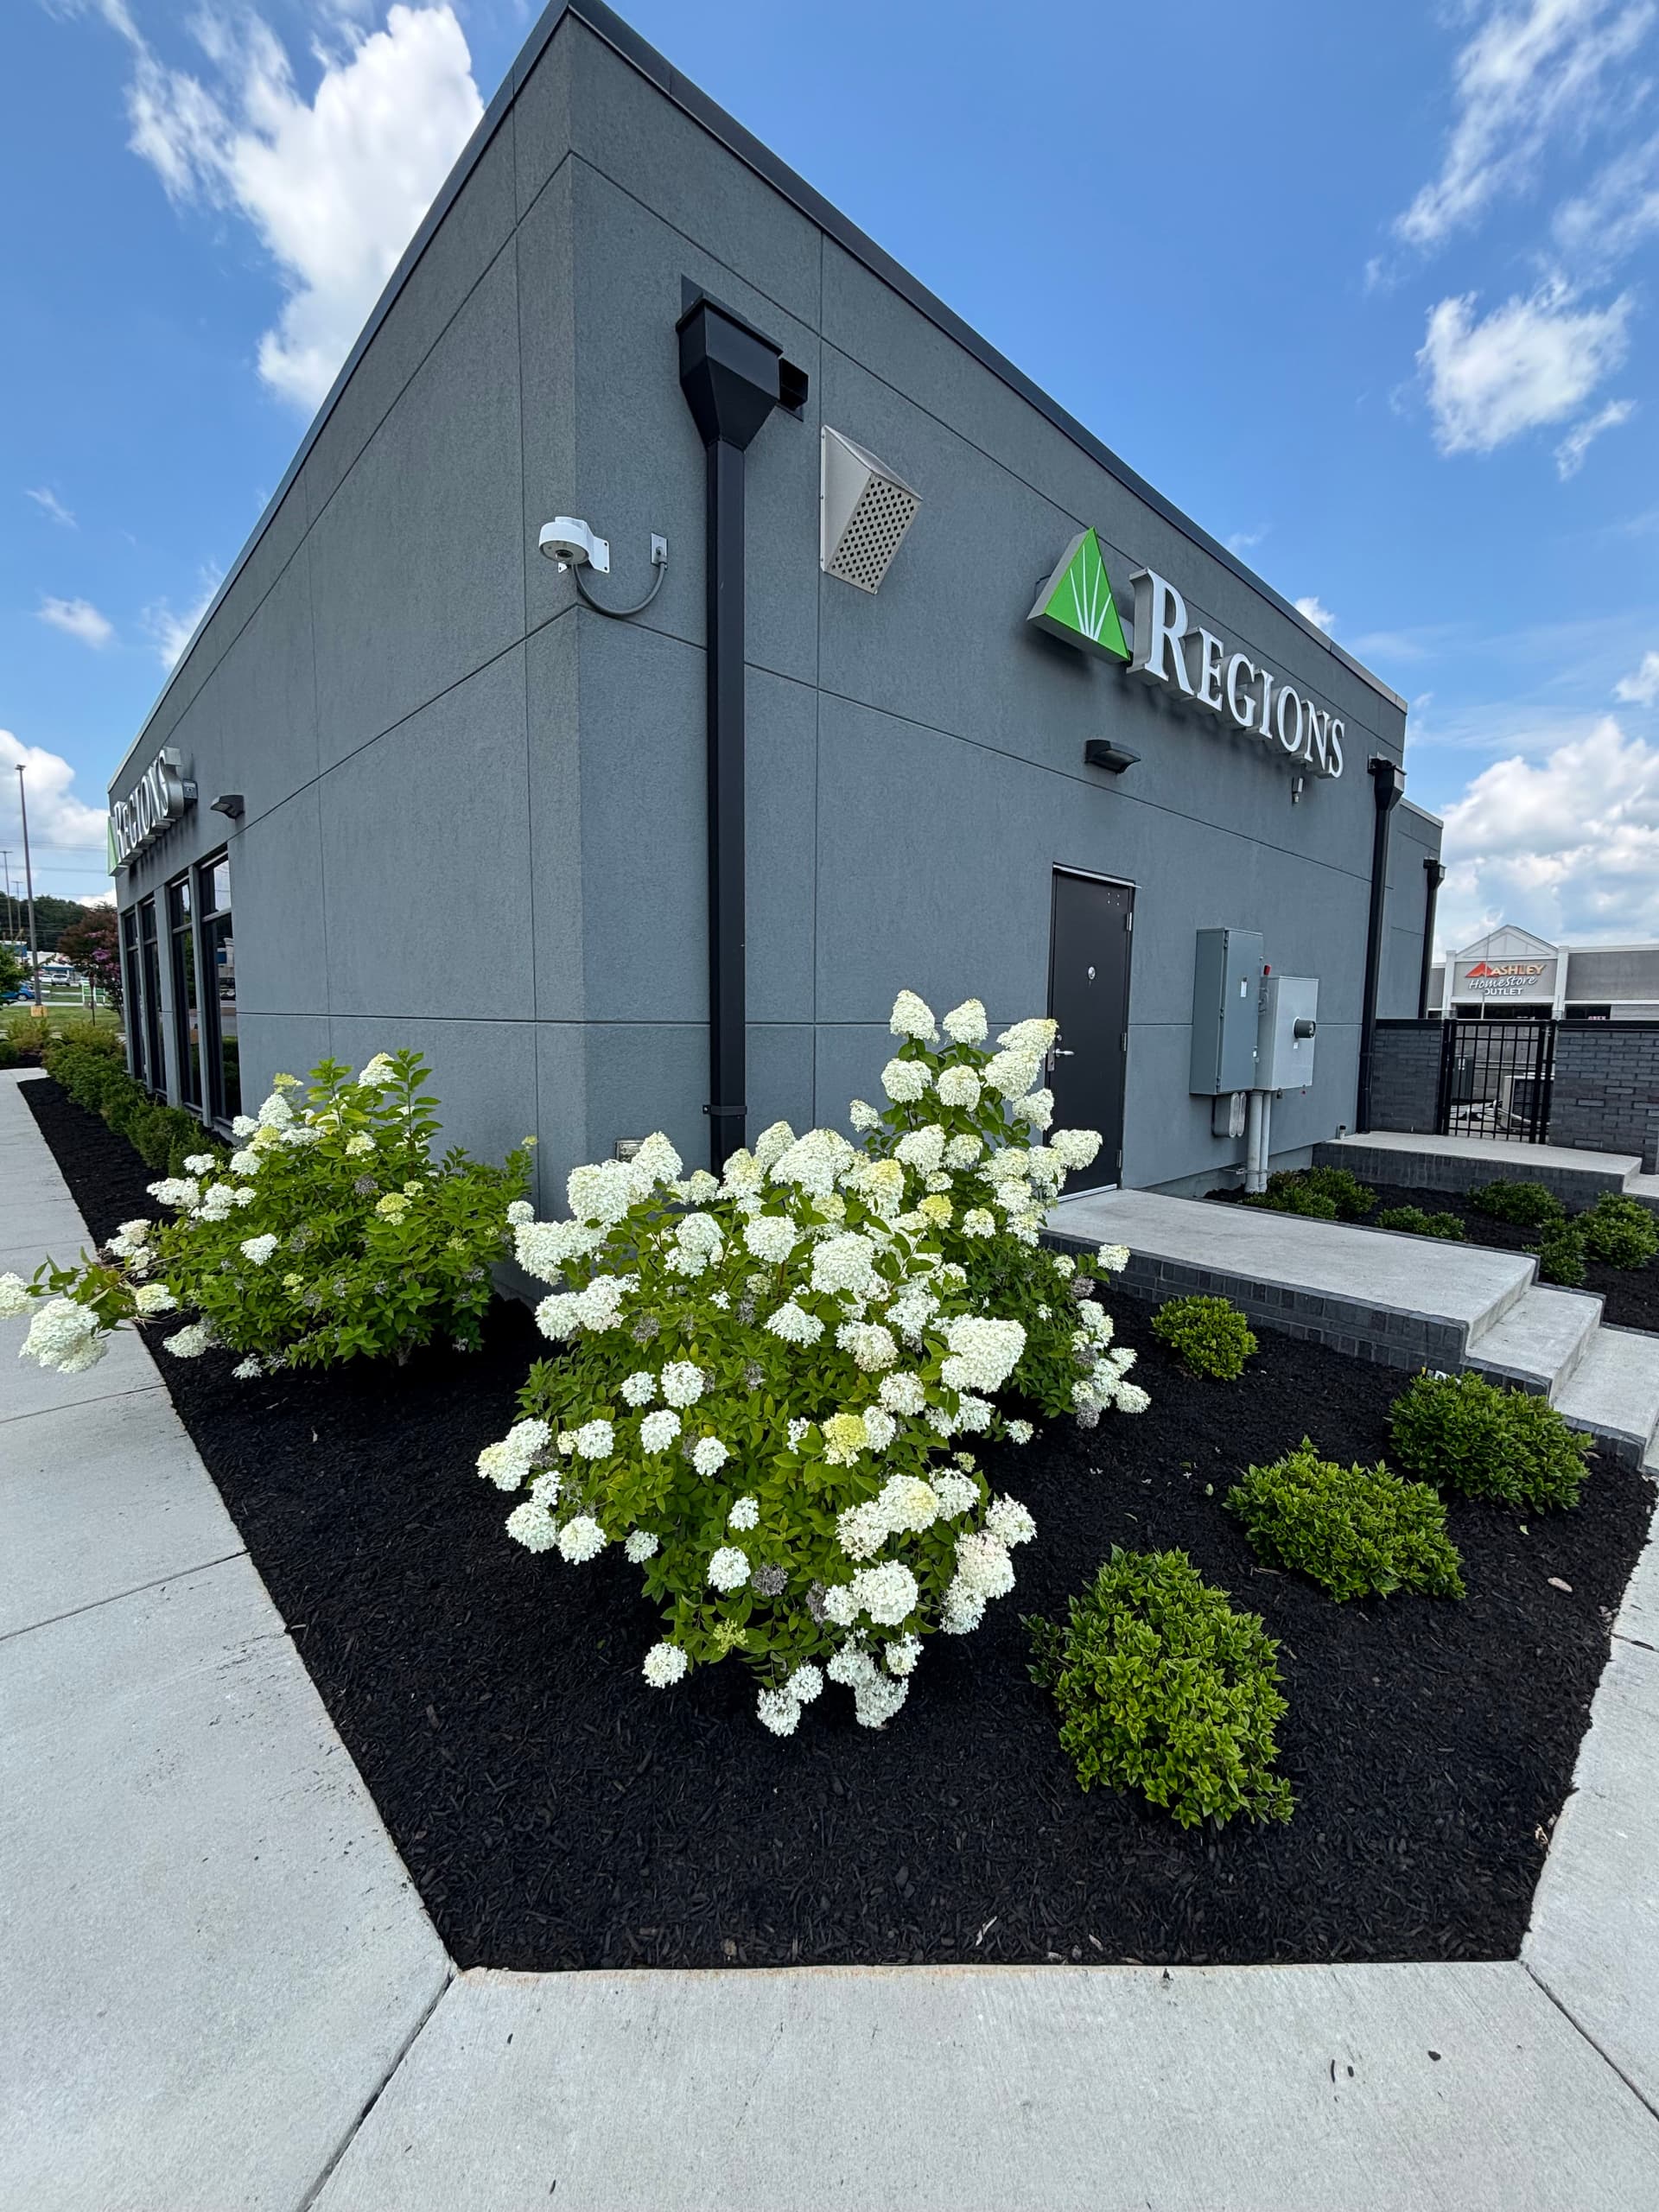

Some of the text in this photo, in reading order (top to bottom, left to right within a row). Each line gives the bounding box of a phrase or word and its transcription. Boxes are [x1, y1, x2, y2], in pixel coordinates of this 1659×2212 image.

[1142, 566, 1345, 779] REGIONS
[113, 747, 172, 864] REGIONS
[1490, 964, 1546, 976] ASHLEY
